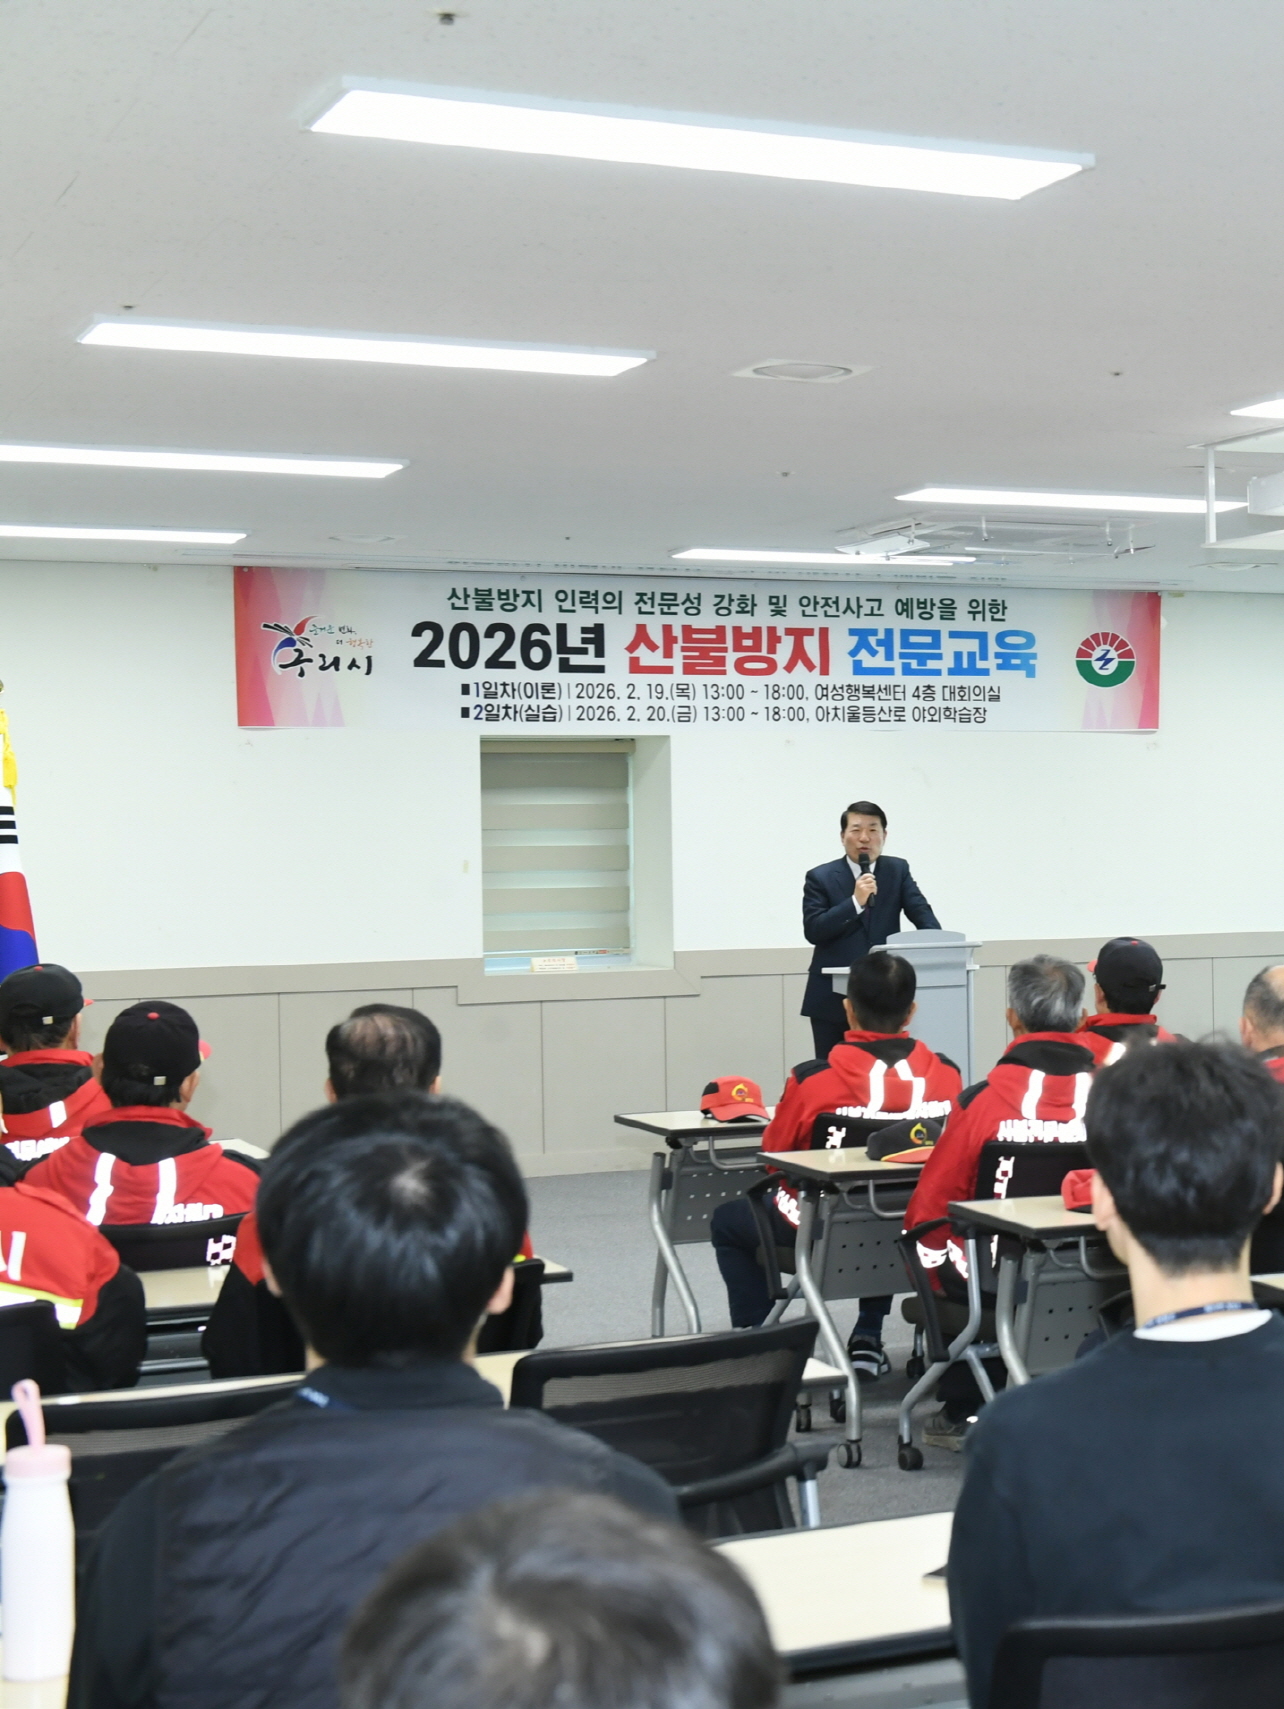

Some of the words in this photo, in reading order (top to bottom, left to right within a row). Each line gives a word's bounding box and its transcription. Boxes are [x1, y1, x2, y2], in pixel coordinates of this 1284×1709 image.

[447, 587, 542, 613] 산불방지
[555, 589, 623, 615] 인력의
[634, 591, 701, 616] 전문성
[713, 593, 757, 617] 강화
[768, 594, 787, 617] 및
[798, 595, 884, 619] 안전사고
[895, 597, 957, 621] 예방을
[967, 599, 1008, 622] 위한
[278, 648, 373, 678] 구리시
[411, 621, 605, 673] 2026년
[625, 624, 829, 676] 산불방지
[848, 628, 1037, 678] 전문교육
[473, 680, 562, 700] 1일차(이론)
[702, 683, 745, 701] 13:00
[814, 683, 906, 702] 여성행복센터
[911, 684, 936, 702] 4층
[941, 684, 1001, 703] 대회의실
[473, 703, 563, 723] 2일차(실습)
[703, 705, 745, 722] 13:00
[815, 705, 907, 723] 아치울등산로
[911, 705, 988, 724] 야외학습장
